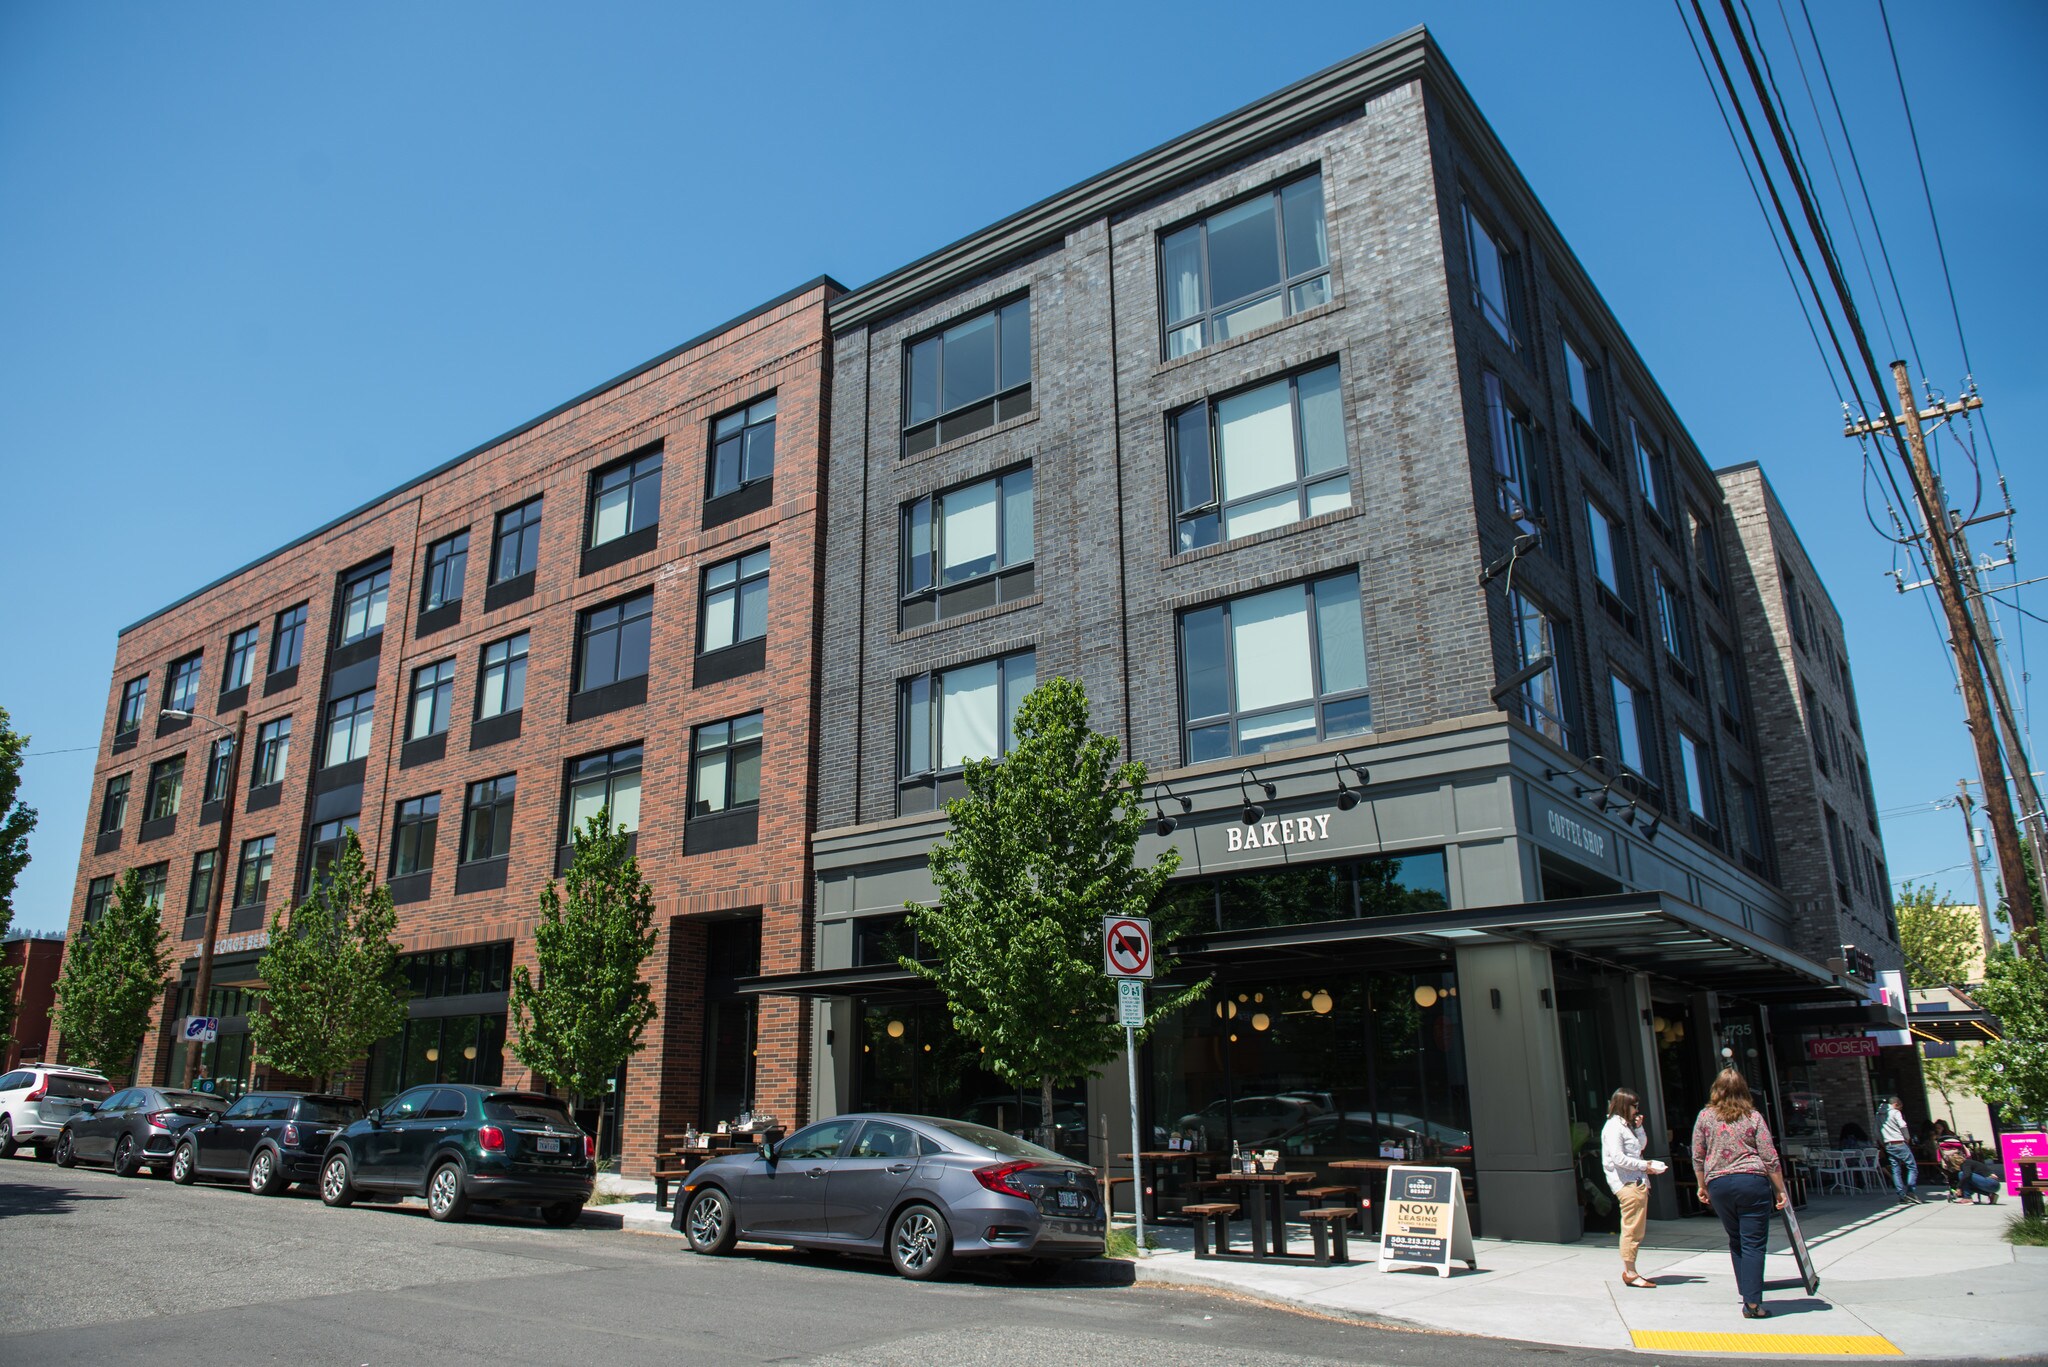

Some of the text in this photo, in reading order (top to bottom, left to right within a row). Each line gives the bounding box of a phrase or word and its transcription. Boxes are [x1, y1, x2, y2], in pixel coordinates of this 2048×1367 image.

[1226, 813, 1331, 852] BAKERY
[1548, 809, 1604, 858] COFFEE SHOP
[213, 936, 245, 954] EORGE
[1723, 1024, 1752, 1036] 1735
[1813, 1040, 1875, 1055] MOBERI
[1399, 1204, 1439, 1215] NOW
